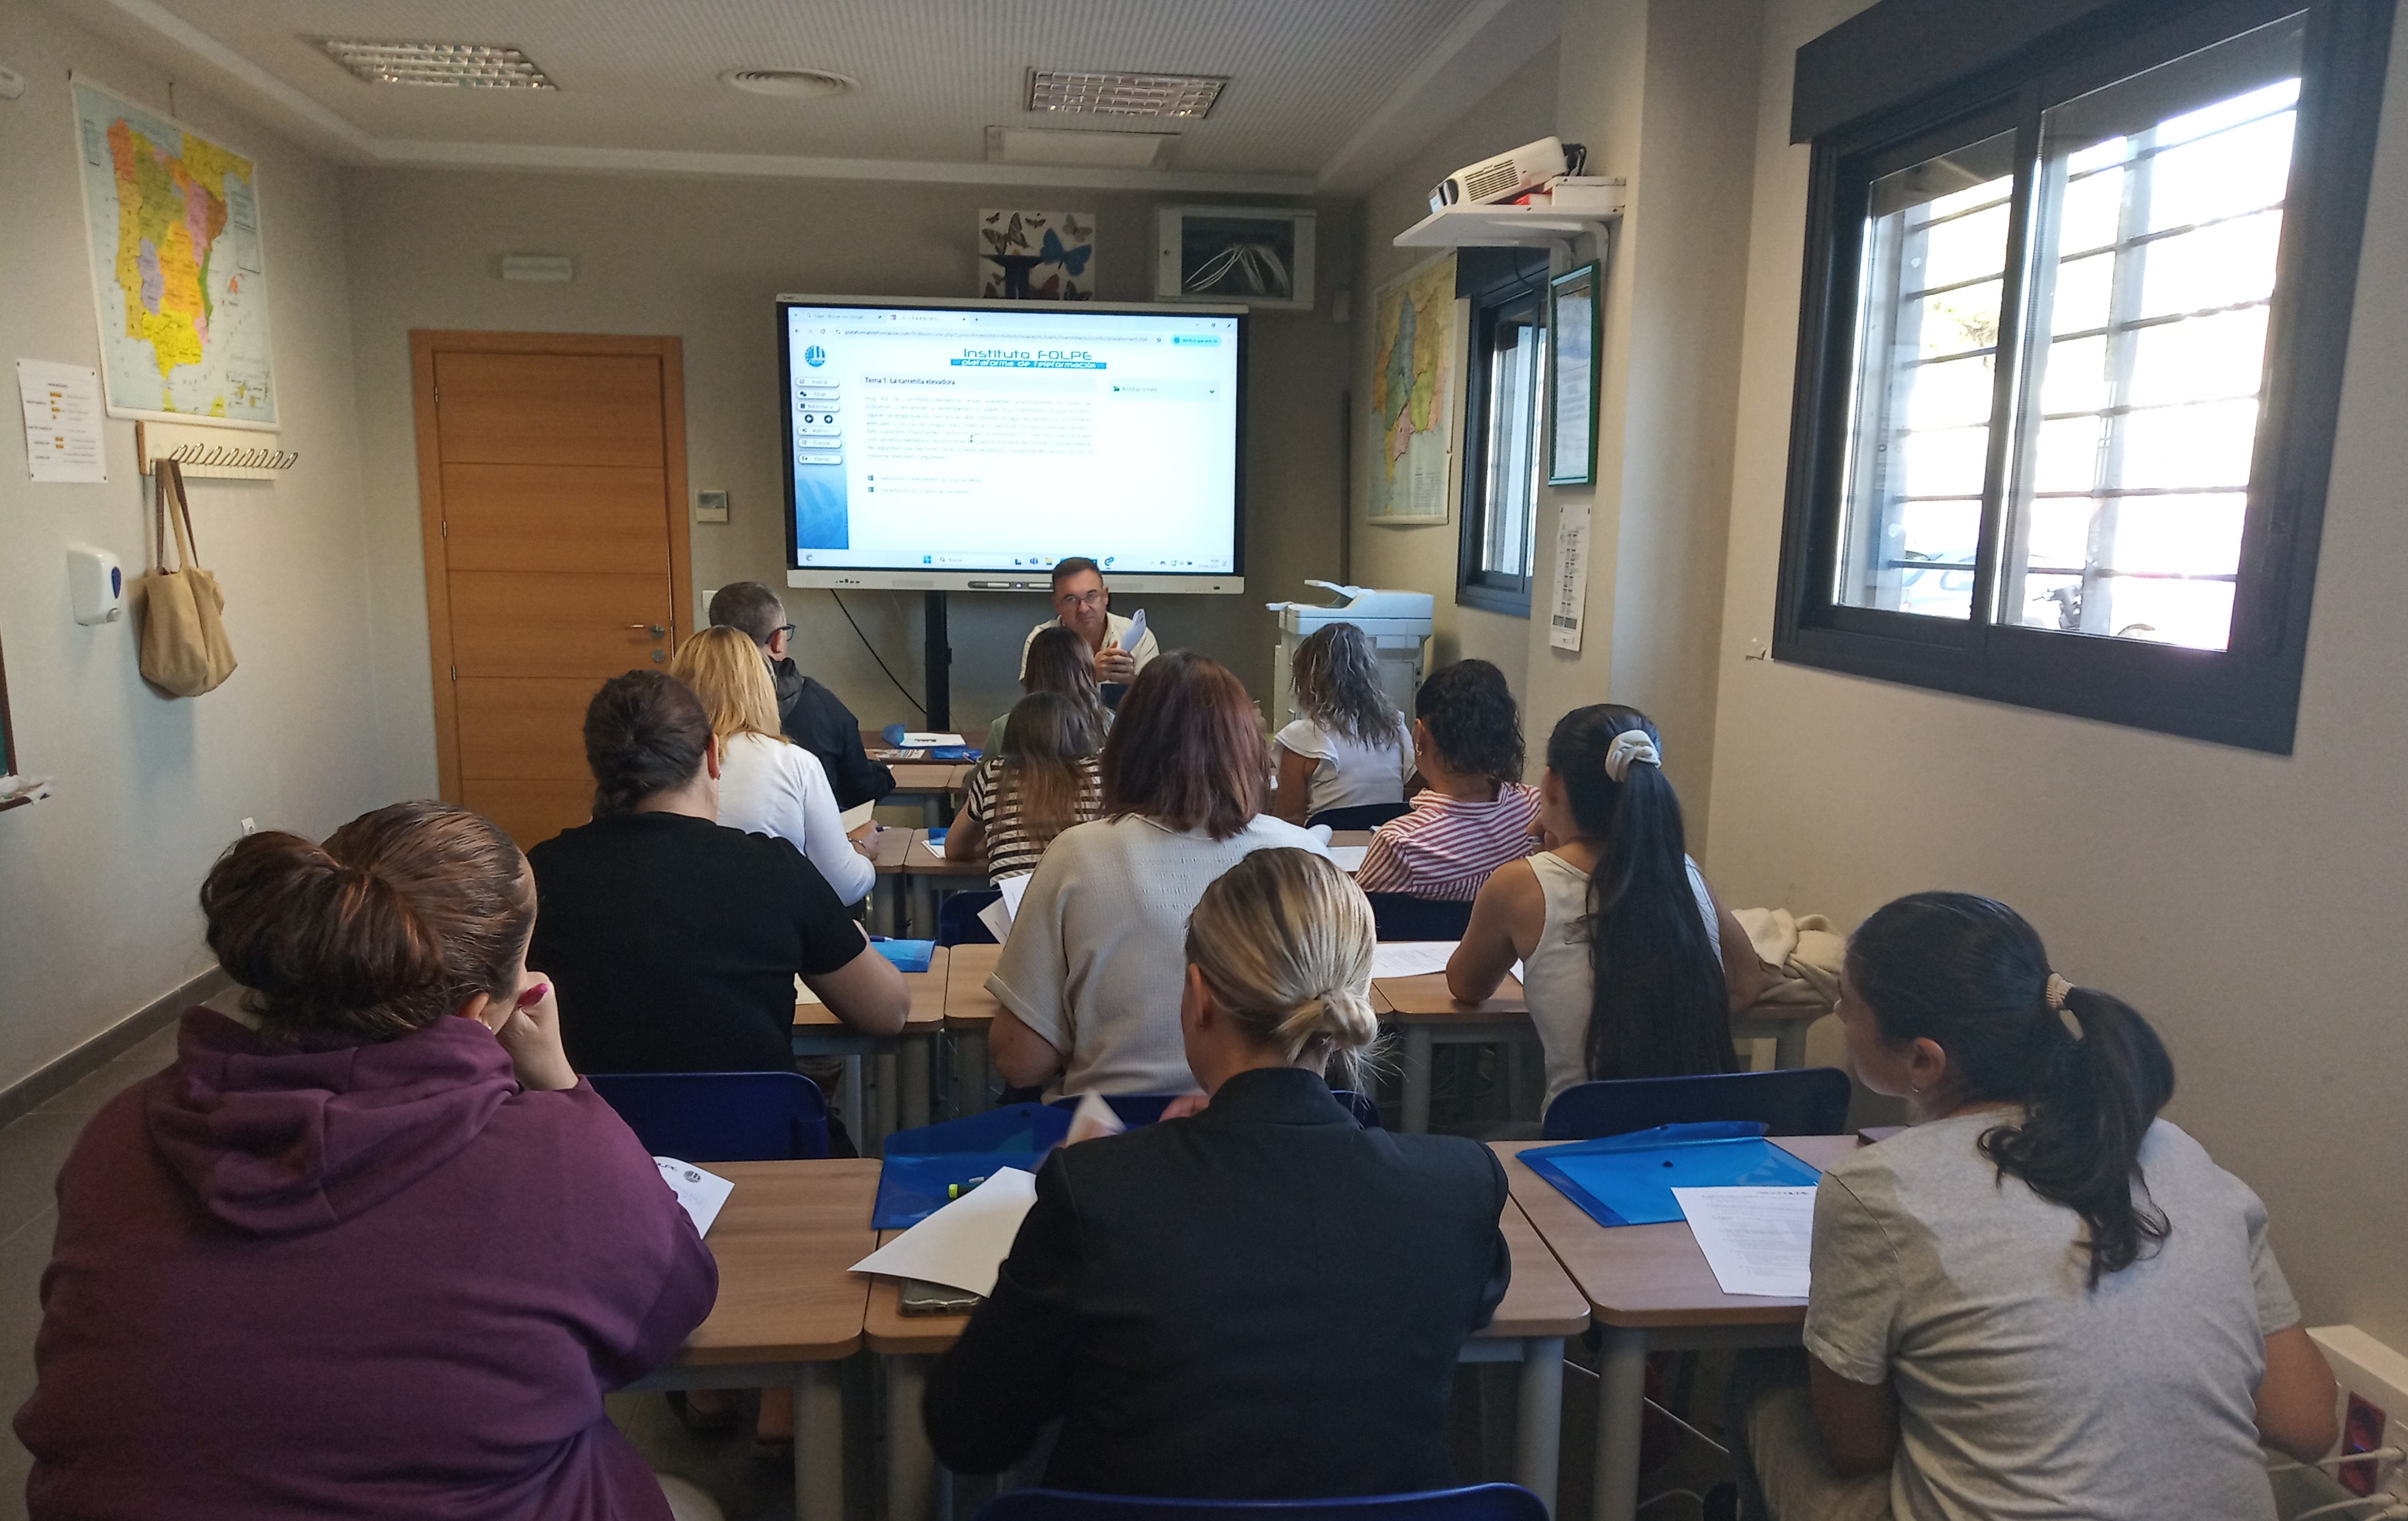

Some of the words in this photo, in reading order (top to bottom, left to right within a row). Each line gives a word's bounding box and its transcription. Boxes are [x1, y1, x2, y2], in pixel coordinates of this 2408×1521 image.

[964, 348, 1030, 359] Instituto
[1038, 350, 1092, 360] FOLPE
[961, 358, 1015, 367] plataforma
[1034, 360, 1096, 369] teleformación
